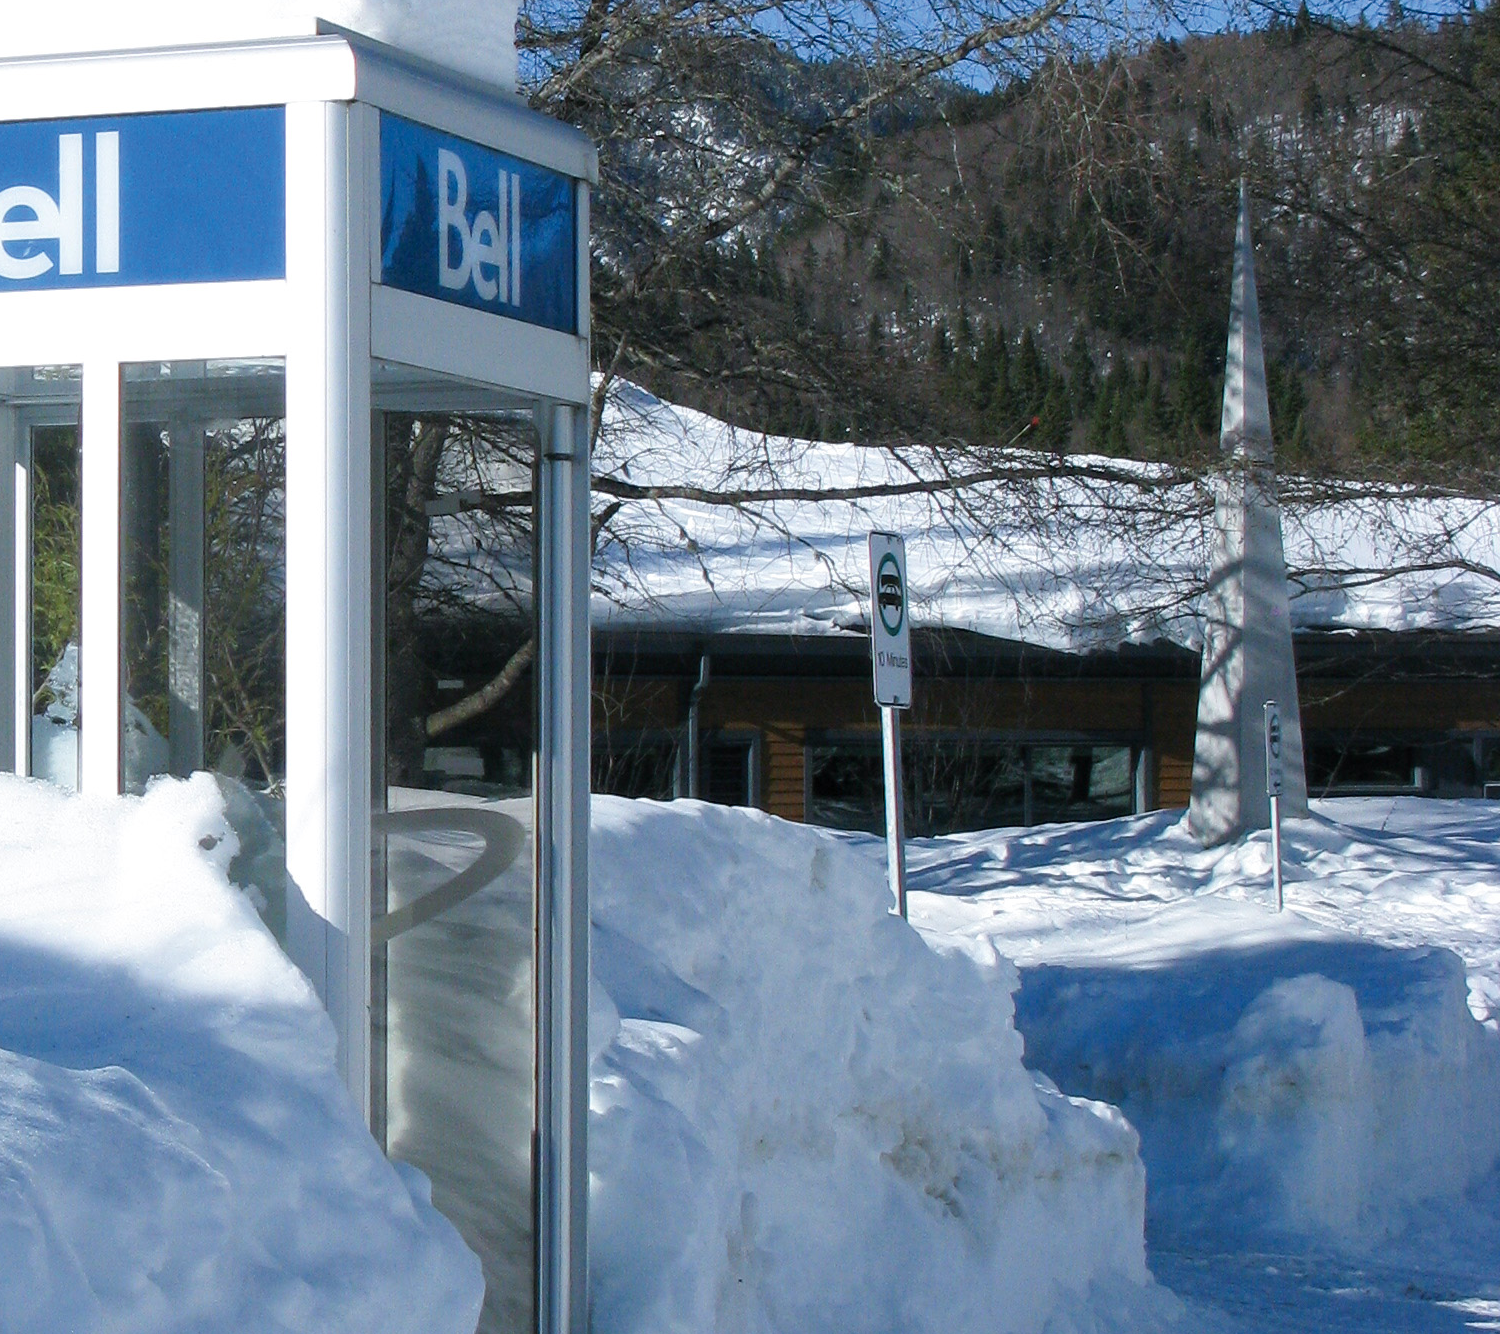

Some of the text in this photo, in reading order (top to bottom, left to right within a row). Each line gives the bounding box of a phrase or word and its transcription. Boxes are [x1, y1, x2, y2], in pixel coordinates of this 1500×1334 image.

[438, 146, 521, 308] Bell
[877, 651, 909, 669] 10 Minutes
